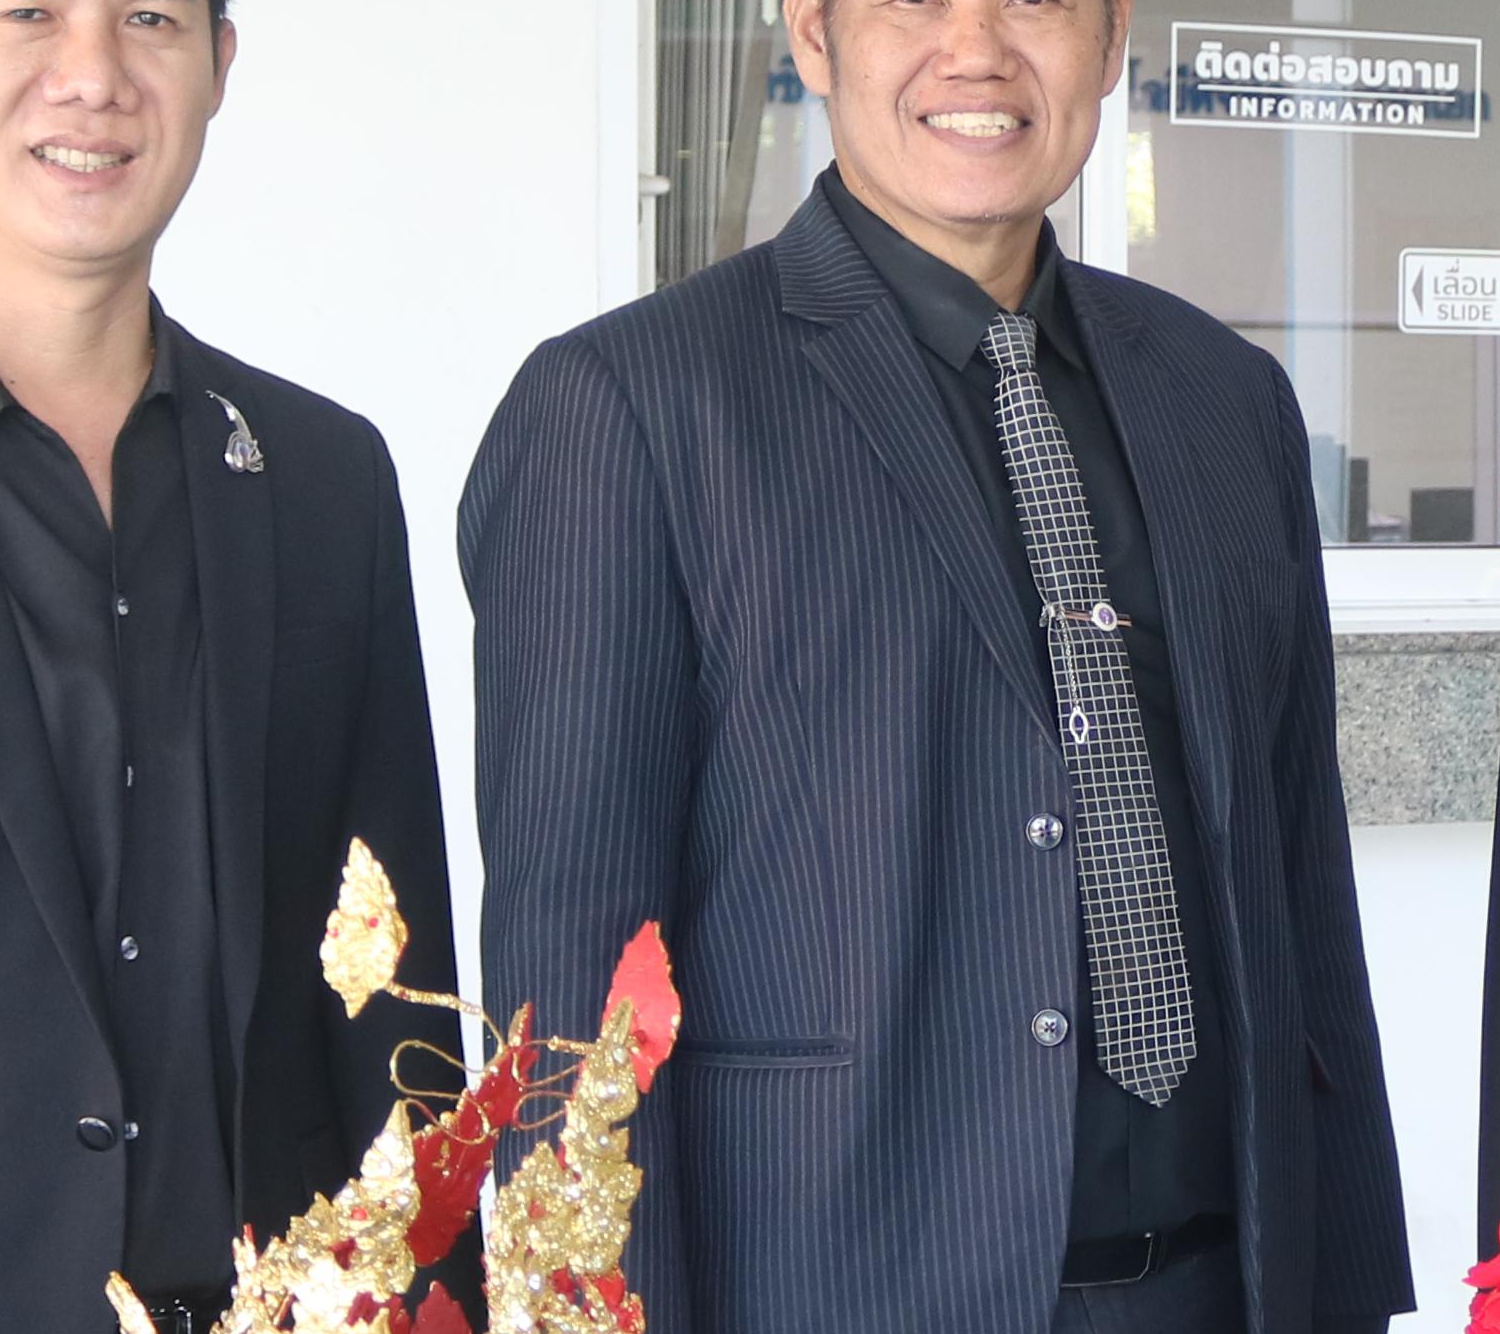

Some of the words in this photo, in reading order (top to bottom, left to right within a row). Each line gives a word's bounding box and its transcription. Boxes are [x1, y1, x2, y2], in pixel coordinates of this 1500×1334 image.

[1194, 40, 1460, 92] ติดต่อสอบถาม
[1228, 95, 1425, 125] INFORMATION
[1432, 259, 1497, 297] เลื่อน
[1436, 303, 1494, 322] SLIDE
